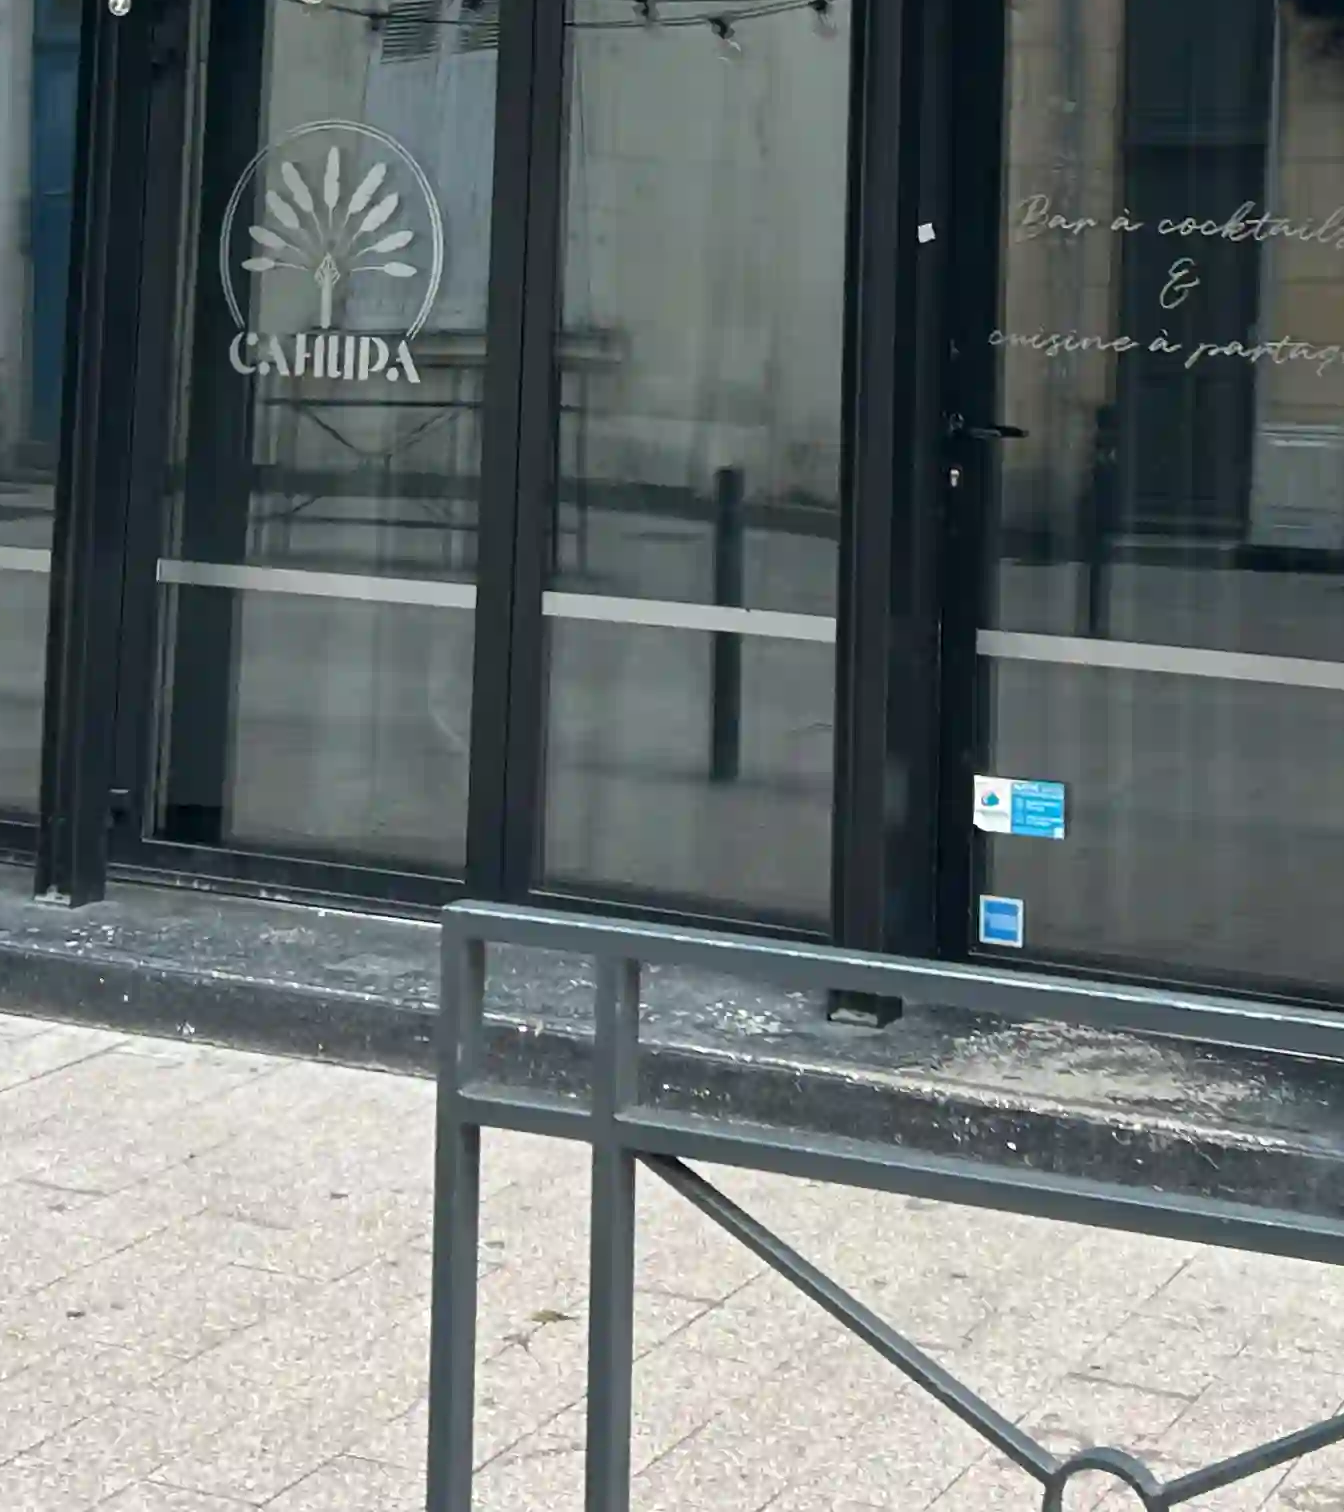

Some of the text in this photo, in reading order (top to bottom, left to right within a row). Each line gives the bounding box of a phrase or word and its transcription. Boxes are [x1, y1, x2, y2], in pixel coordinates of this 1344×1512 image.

[1012, 193, 1097, 244] Bar
[1110, 207, 1145, 233] à
[1157, 257, 1202, 310] &
[228, 331, 421, 385] CAHUPA
[987, 324, 1140, 357] cuisine
[1147, 328, 1182, 353] à
